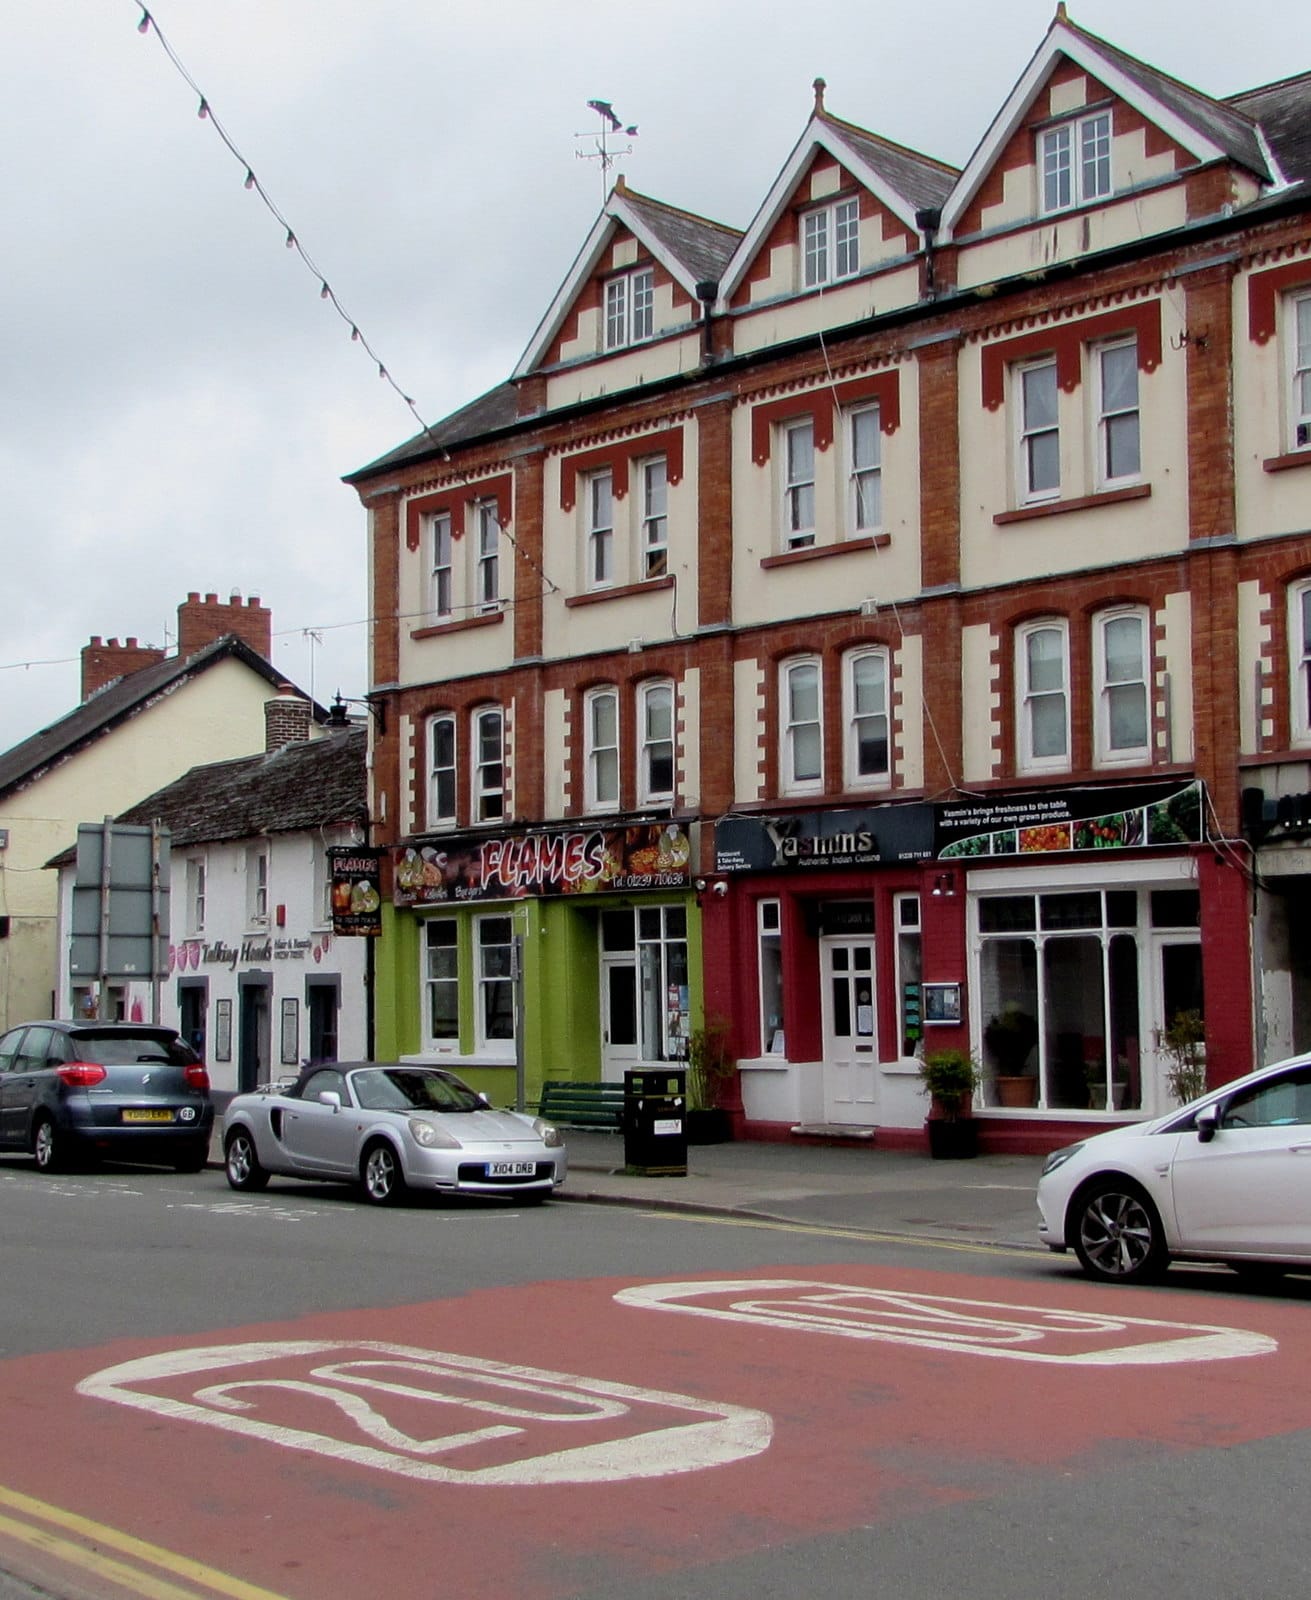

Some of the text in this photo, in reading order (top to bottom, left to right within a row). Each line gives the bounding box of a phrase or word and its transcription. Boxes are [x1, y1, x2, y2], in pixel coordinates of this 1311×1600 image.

[973, 807, 994, 816] brings
[995, 803, 1028, 813] freshness
[1038, 801, 1049, 809] the
[1050, 800, 1067, 808] table
[940, 819, 953, 827] with
[960, 816, 981, 826] variety
[982, 816, 989, 824] of
[1004, 814, 1018, 822] own
[1019, 812, 1040, 822] grown
[480, 830, 606, 888] FLAMES
[799, 854, 881, 866] Authentic Indian Cuisine
[627, 872, 652, 887] 01239
[654, 871, 684, 886] 710636
[202, 938, 272, 972] Talking Heads
[182, 1109, 194, 1118] GB
[192, 1359, 632, 1455] 20
